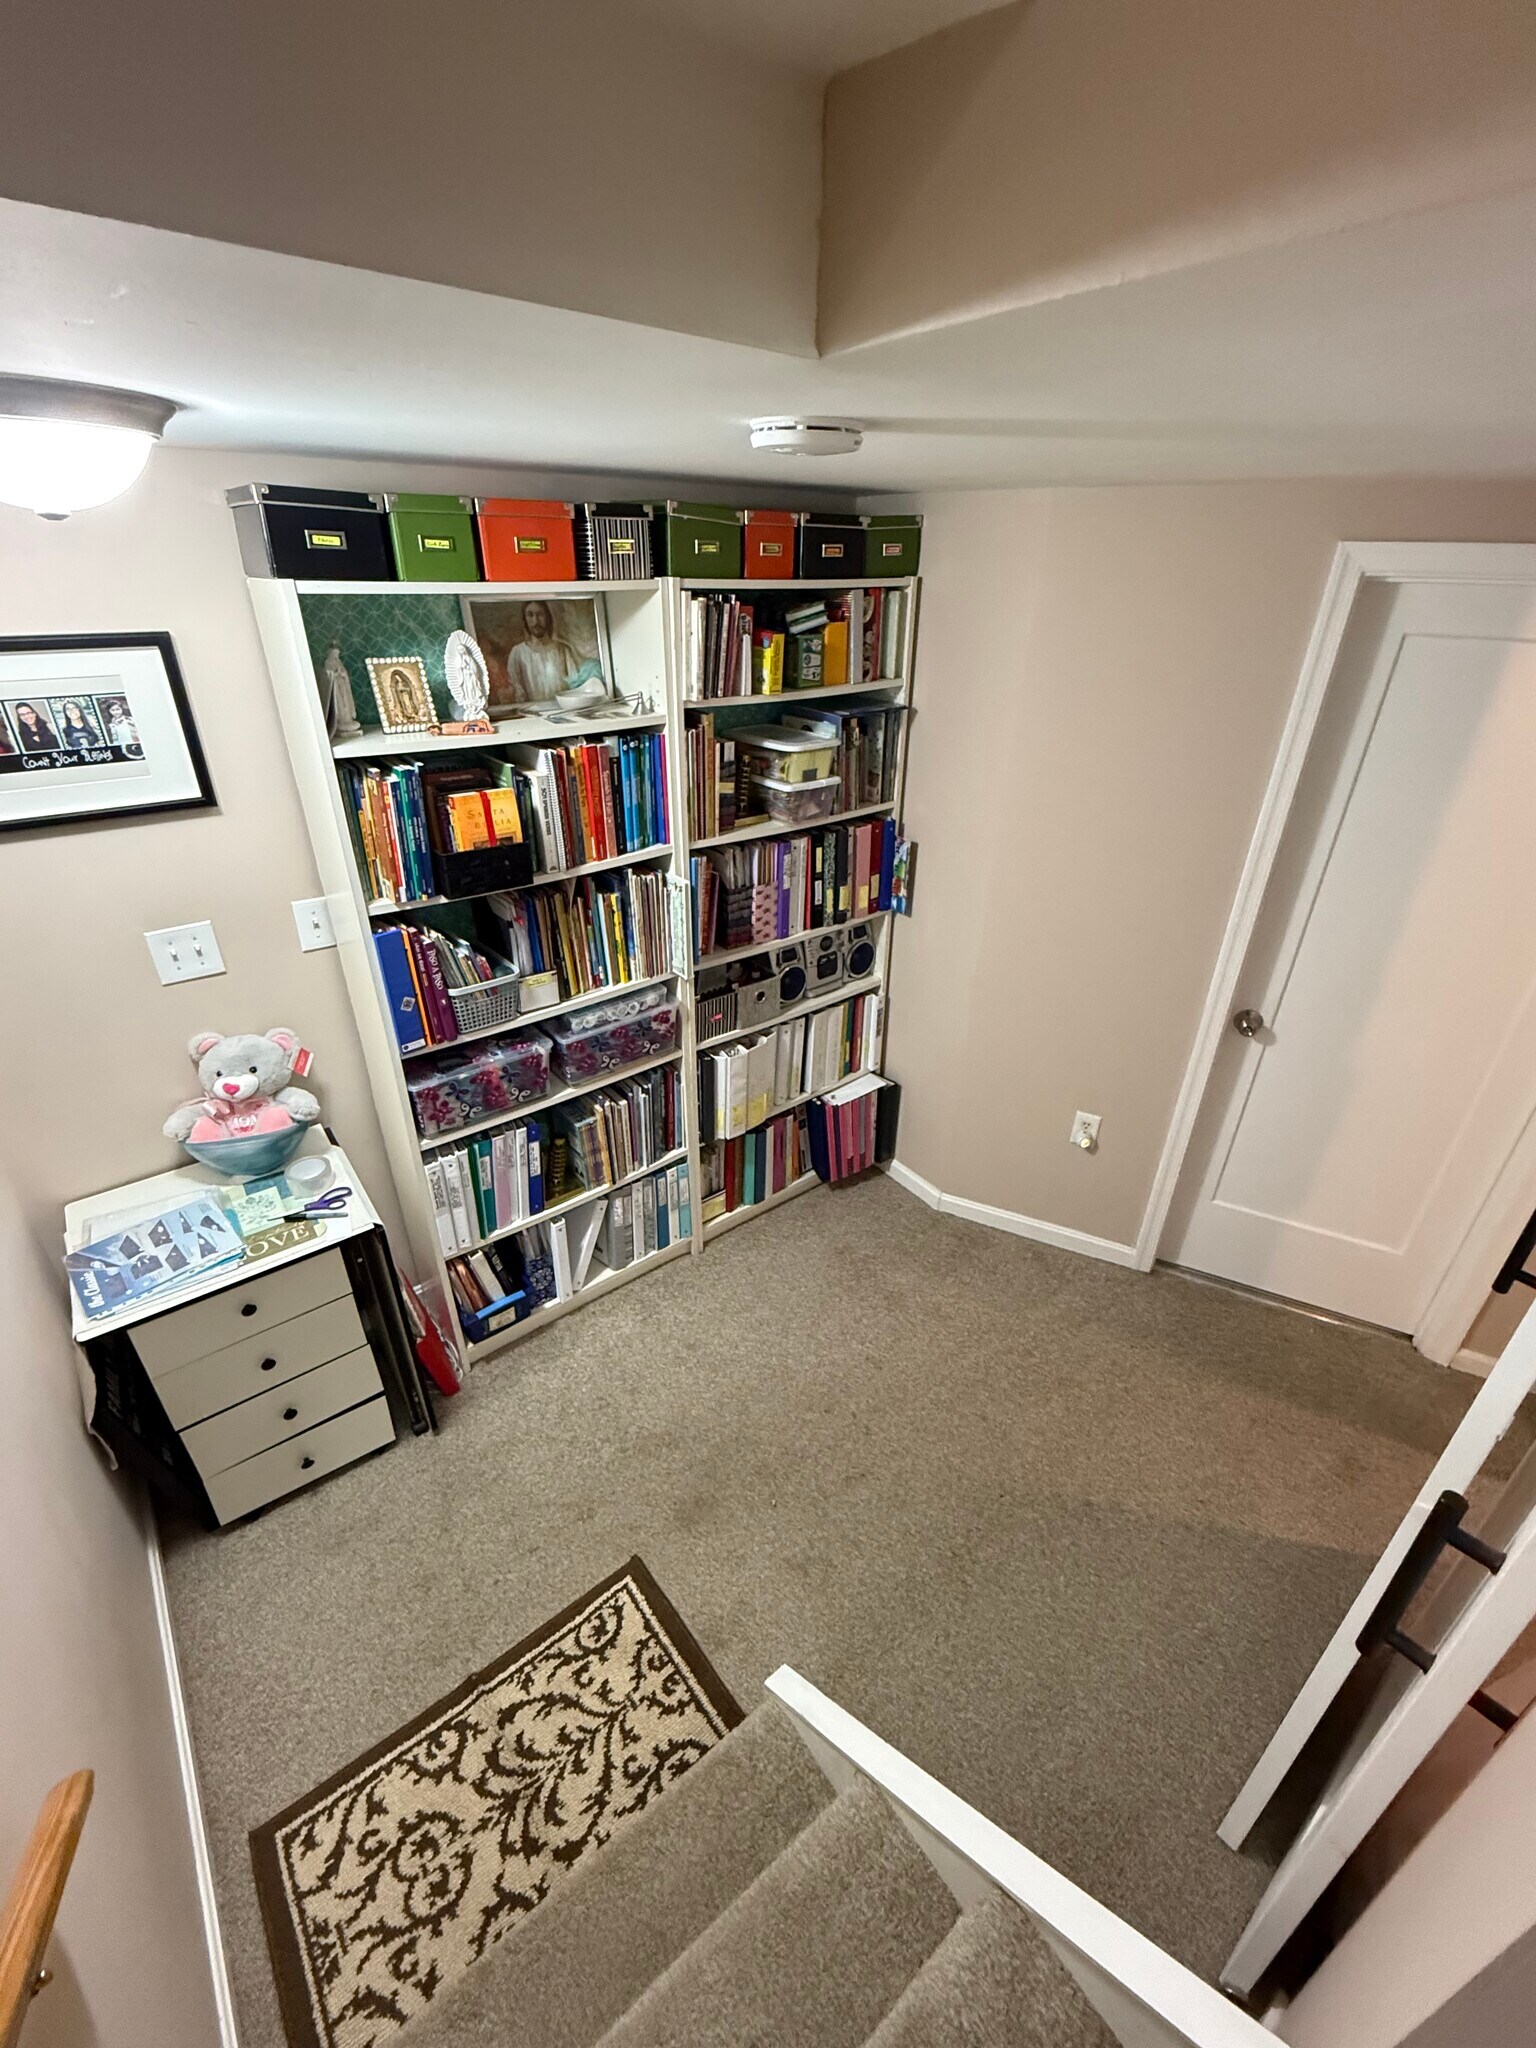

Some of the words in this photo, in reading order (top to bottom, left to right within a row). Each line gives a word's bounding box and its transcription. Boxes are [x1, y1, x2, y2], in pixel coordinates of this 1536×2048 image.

[466, 808, 505, 820] SATA
[474, 818, 512, 829] BLIA
[427, 949, 439, 966] PASO
[432, 972, 445, 990] PASO
[244, 1225, 310, 1259] OVE
